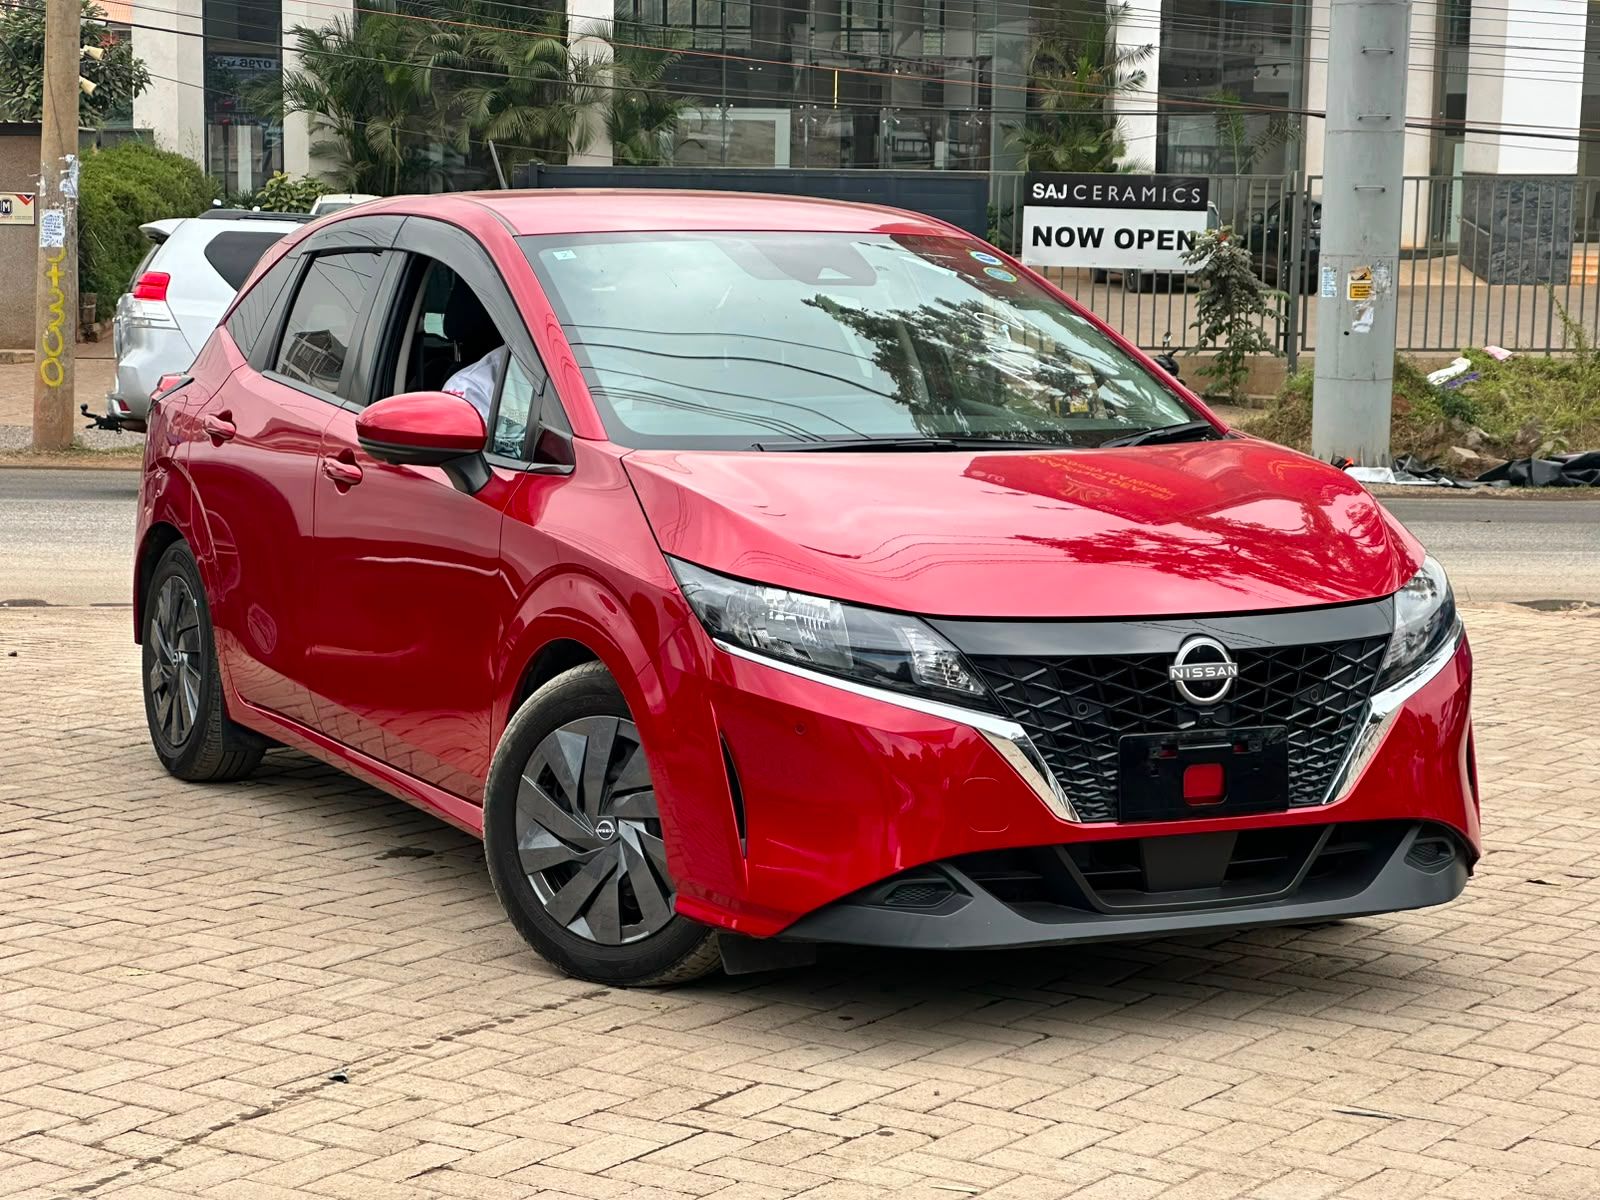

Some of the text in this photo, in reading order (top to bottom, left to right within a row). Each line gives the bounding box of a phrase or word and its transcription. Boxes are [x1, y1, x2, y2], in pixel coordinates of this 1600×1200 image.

[1032, 183, 1201, 204] SAJ CERAMICS
[1032, 225, 1196, 251] NOW OPEN
[1171, 665, 1238, 679] NISSAN
